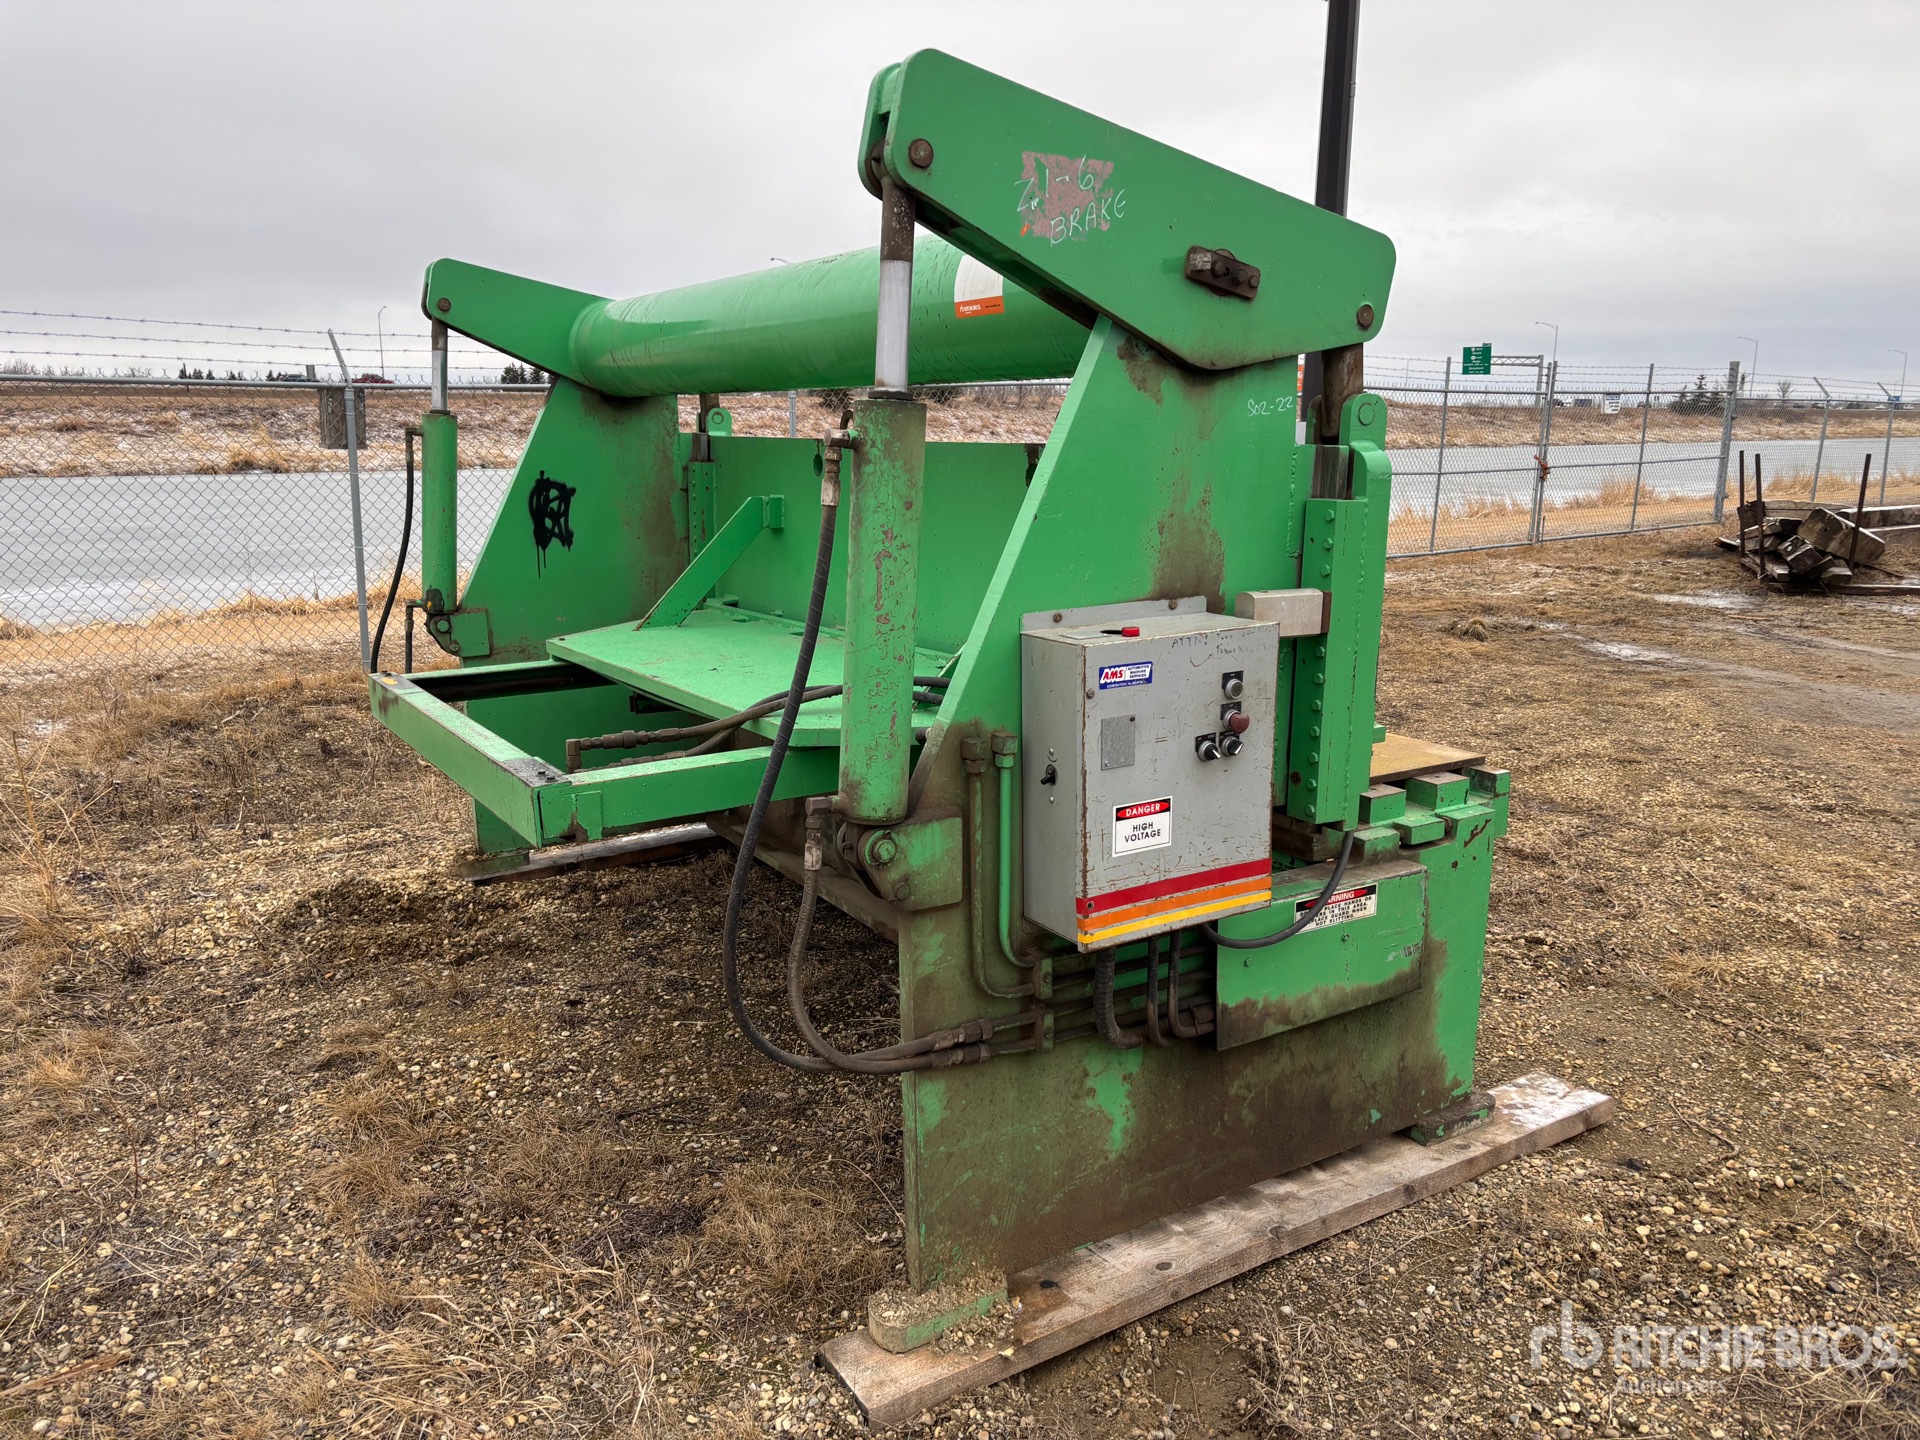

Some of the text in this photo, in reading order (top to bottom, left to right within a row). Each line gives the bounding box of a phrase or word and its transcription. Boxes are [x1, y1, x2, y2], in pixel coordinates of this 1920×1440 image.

[1050, 188, 1126, 247] BRAKE
[1103, 670, 1124, 680] AMS
[1126, 803, 1161, 817] DANGER
[1132, 821, 1154, 833] HIGH
[1124, 828, 1161, 843] VOLTAGE
[1328, 891, 1354, 903] ARNING
[1324, 903, 1341, 911] PLACE
[1329, 914, 1356, 923] SLITTING.
[1331, 910, 1349, 918] GUARD
